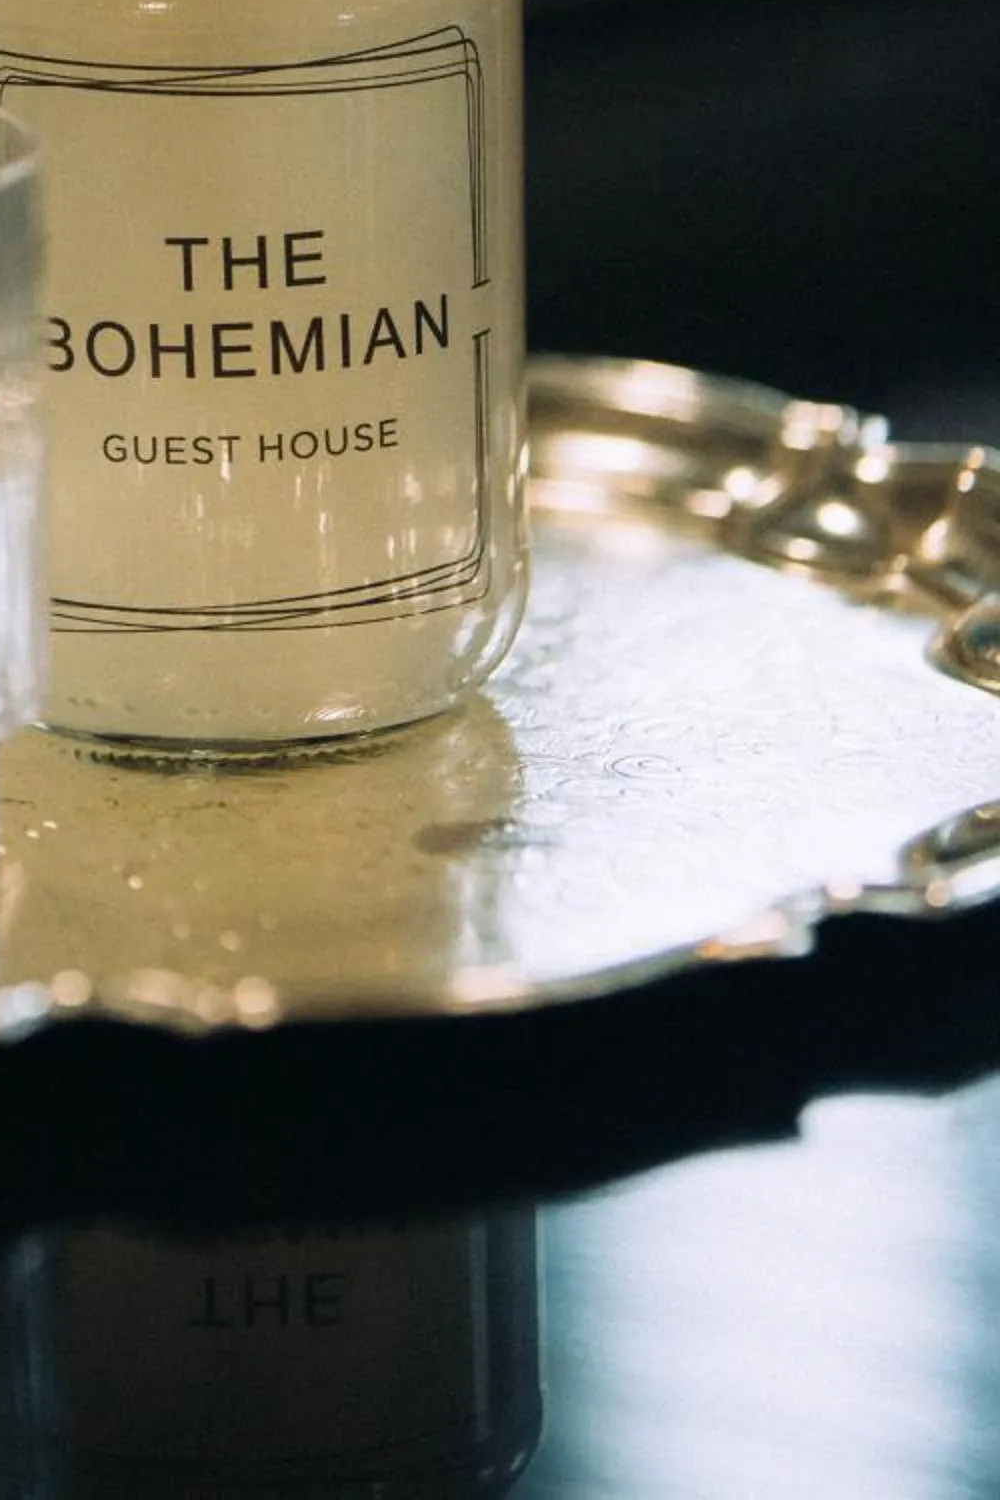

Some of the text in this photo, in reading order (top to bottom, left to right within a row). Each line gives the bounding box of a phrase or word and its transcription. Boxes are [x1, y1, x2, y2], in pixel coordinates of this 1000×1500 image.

[164, 230, 327, 292] THE
[45, 293, 450, 379] BOHEMIAN
[102, 418, 399, 465] GUEST HOUSE
